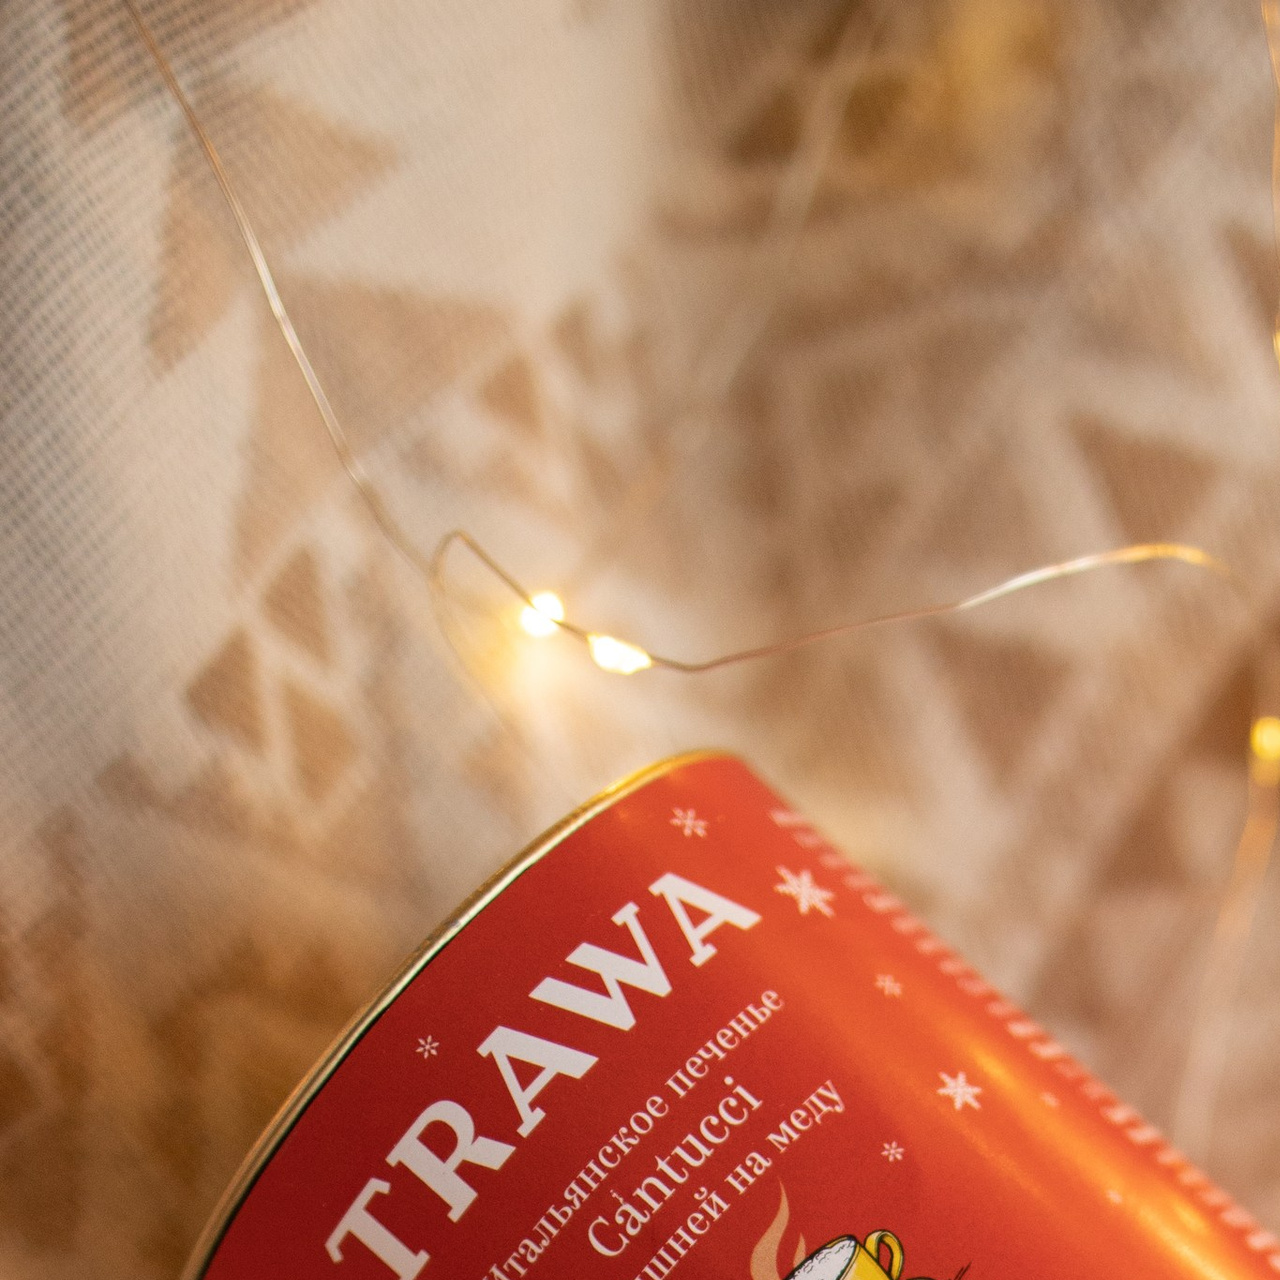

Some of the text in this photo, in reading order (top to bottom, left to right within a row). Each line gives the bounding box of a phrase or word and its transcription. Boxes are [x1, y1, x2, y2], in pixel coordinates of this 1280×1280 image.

[664, 988, 785, 1099] печенье
[587, 1075, 763, 1258] Cantucci
[724, 1151, 773, 1195] на
[765, 1079, 845, 1153] меду
